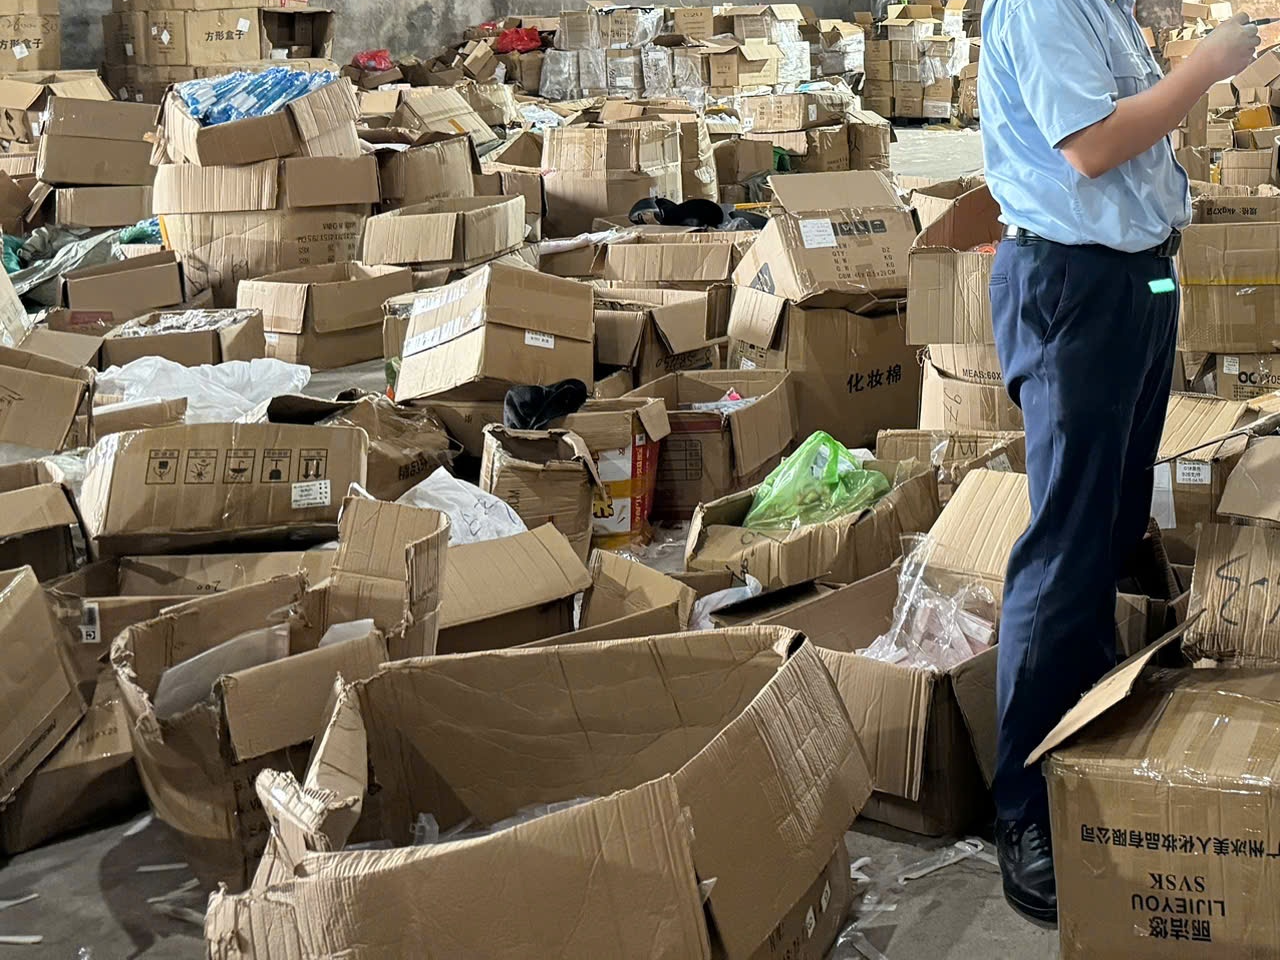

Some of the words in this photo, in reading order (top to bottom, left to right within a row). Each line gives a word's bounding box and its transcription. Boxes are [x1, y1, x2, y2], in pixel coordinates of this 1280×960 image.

[205, 30, 245, 41] 方形盒子
[847, 364, 902, 393] 化妆棉
[1148, 873, 1206, 893] SVSK
[1131, 894, 1226, 917] LIJIEYOU
[1148, 916, 1213, 943] 丽洁悠
